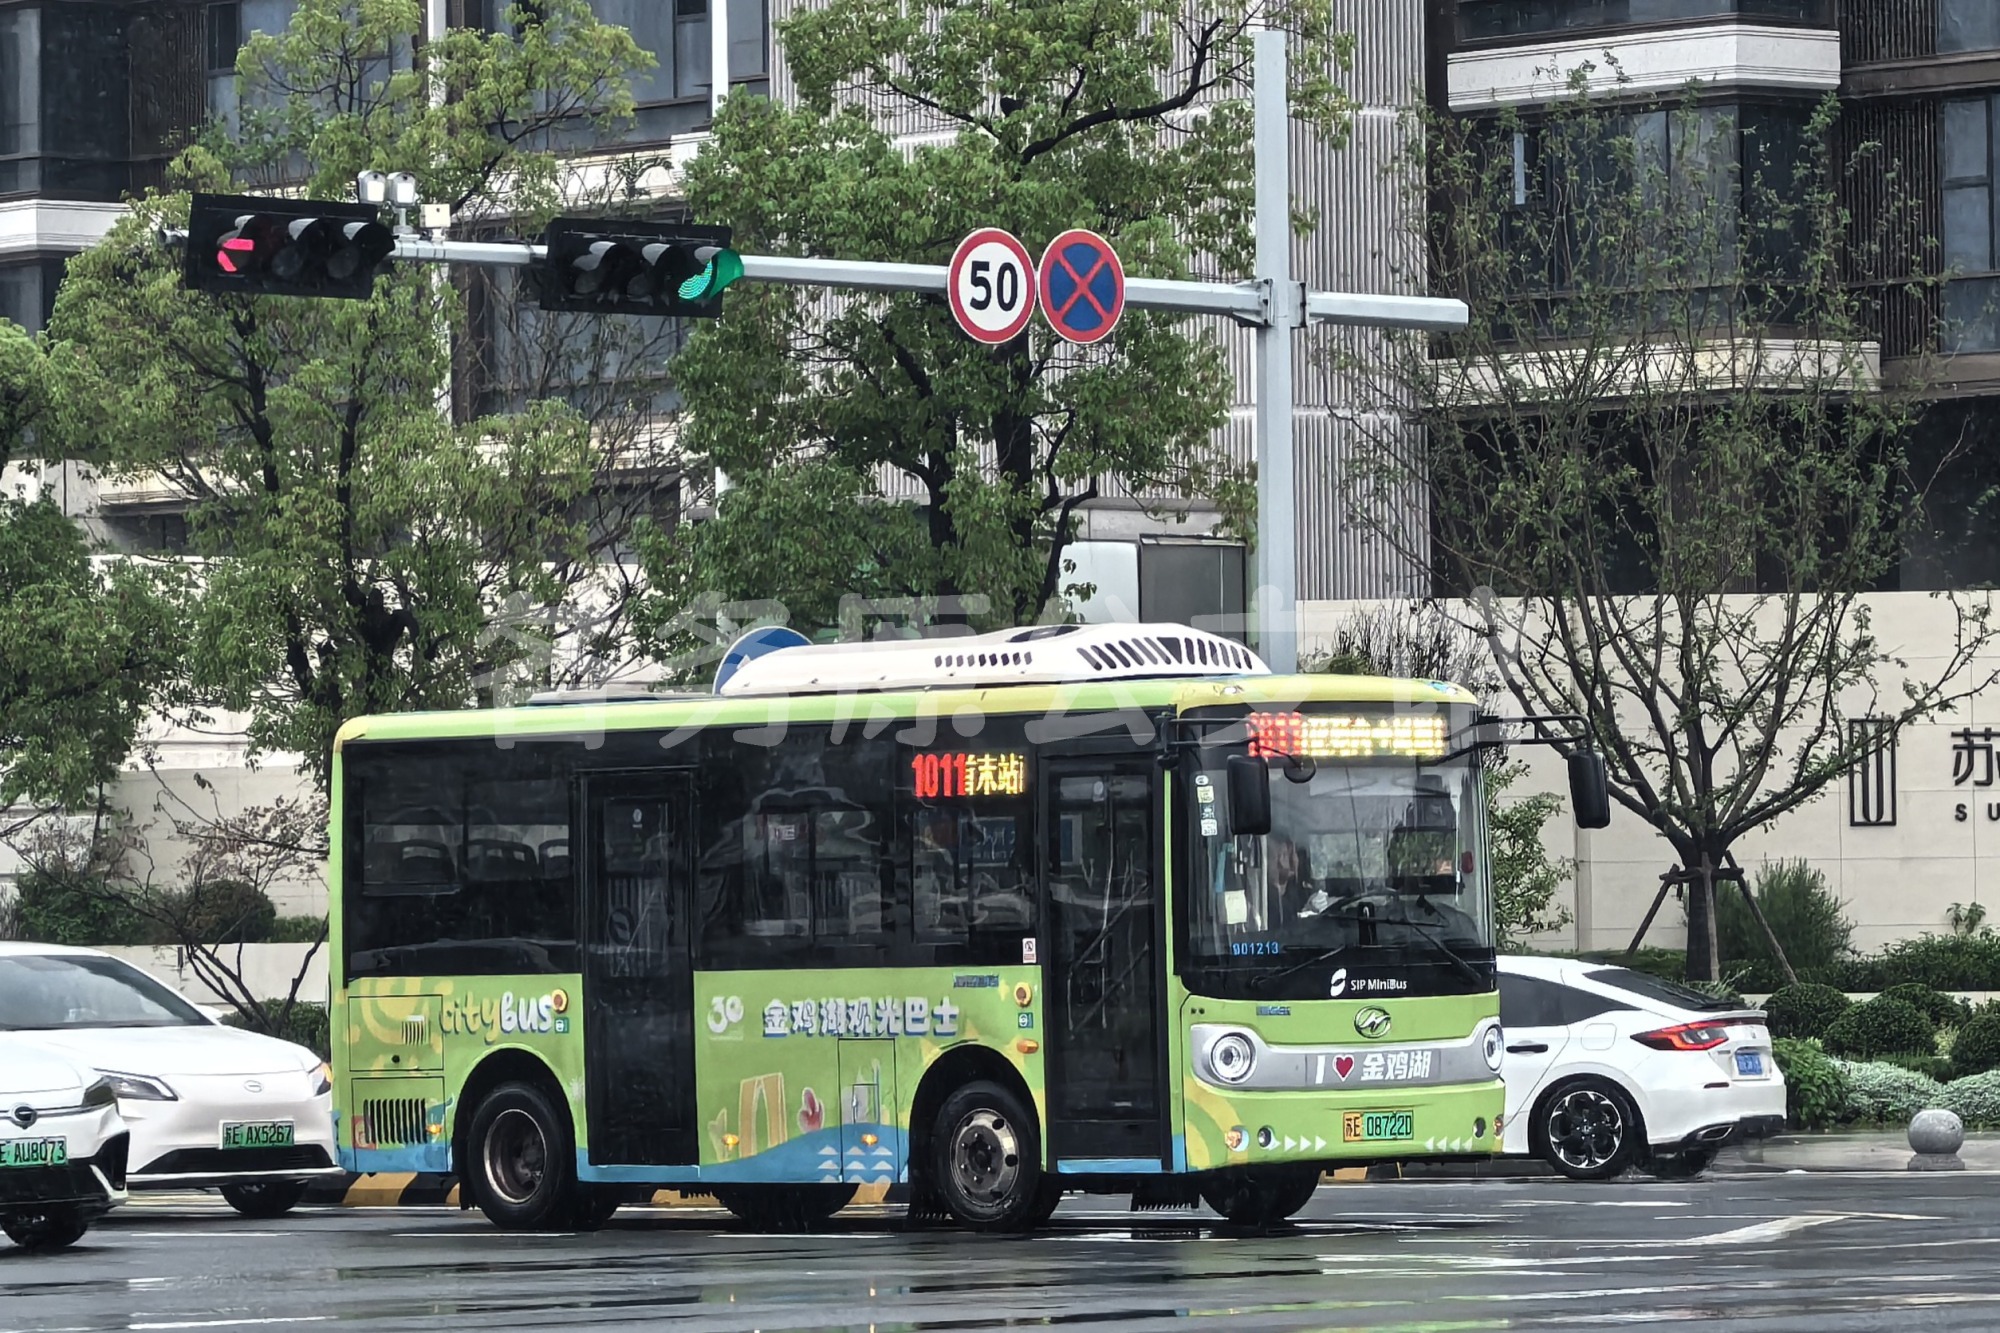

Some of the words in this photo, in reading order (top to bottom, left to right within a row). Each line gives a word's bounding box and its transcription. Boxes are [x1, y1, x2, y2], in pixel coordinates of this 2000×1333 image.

[970, 261, 1018, 311] 50
[1950, 727, 2000, 787] 苏
[1350, 979, 1366, 992] SIP
[762, 995, 960, 1038] 金鸡湖观光巴士
[1360, 1051, 1432, 1081] 金鸡湖
